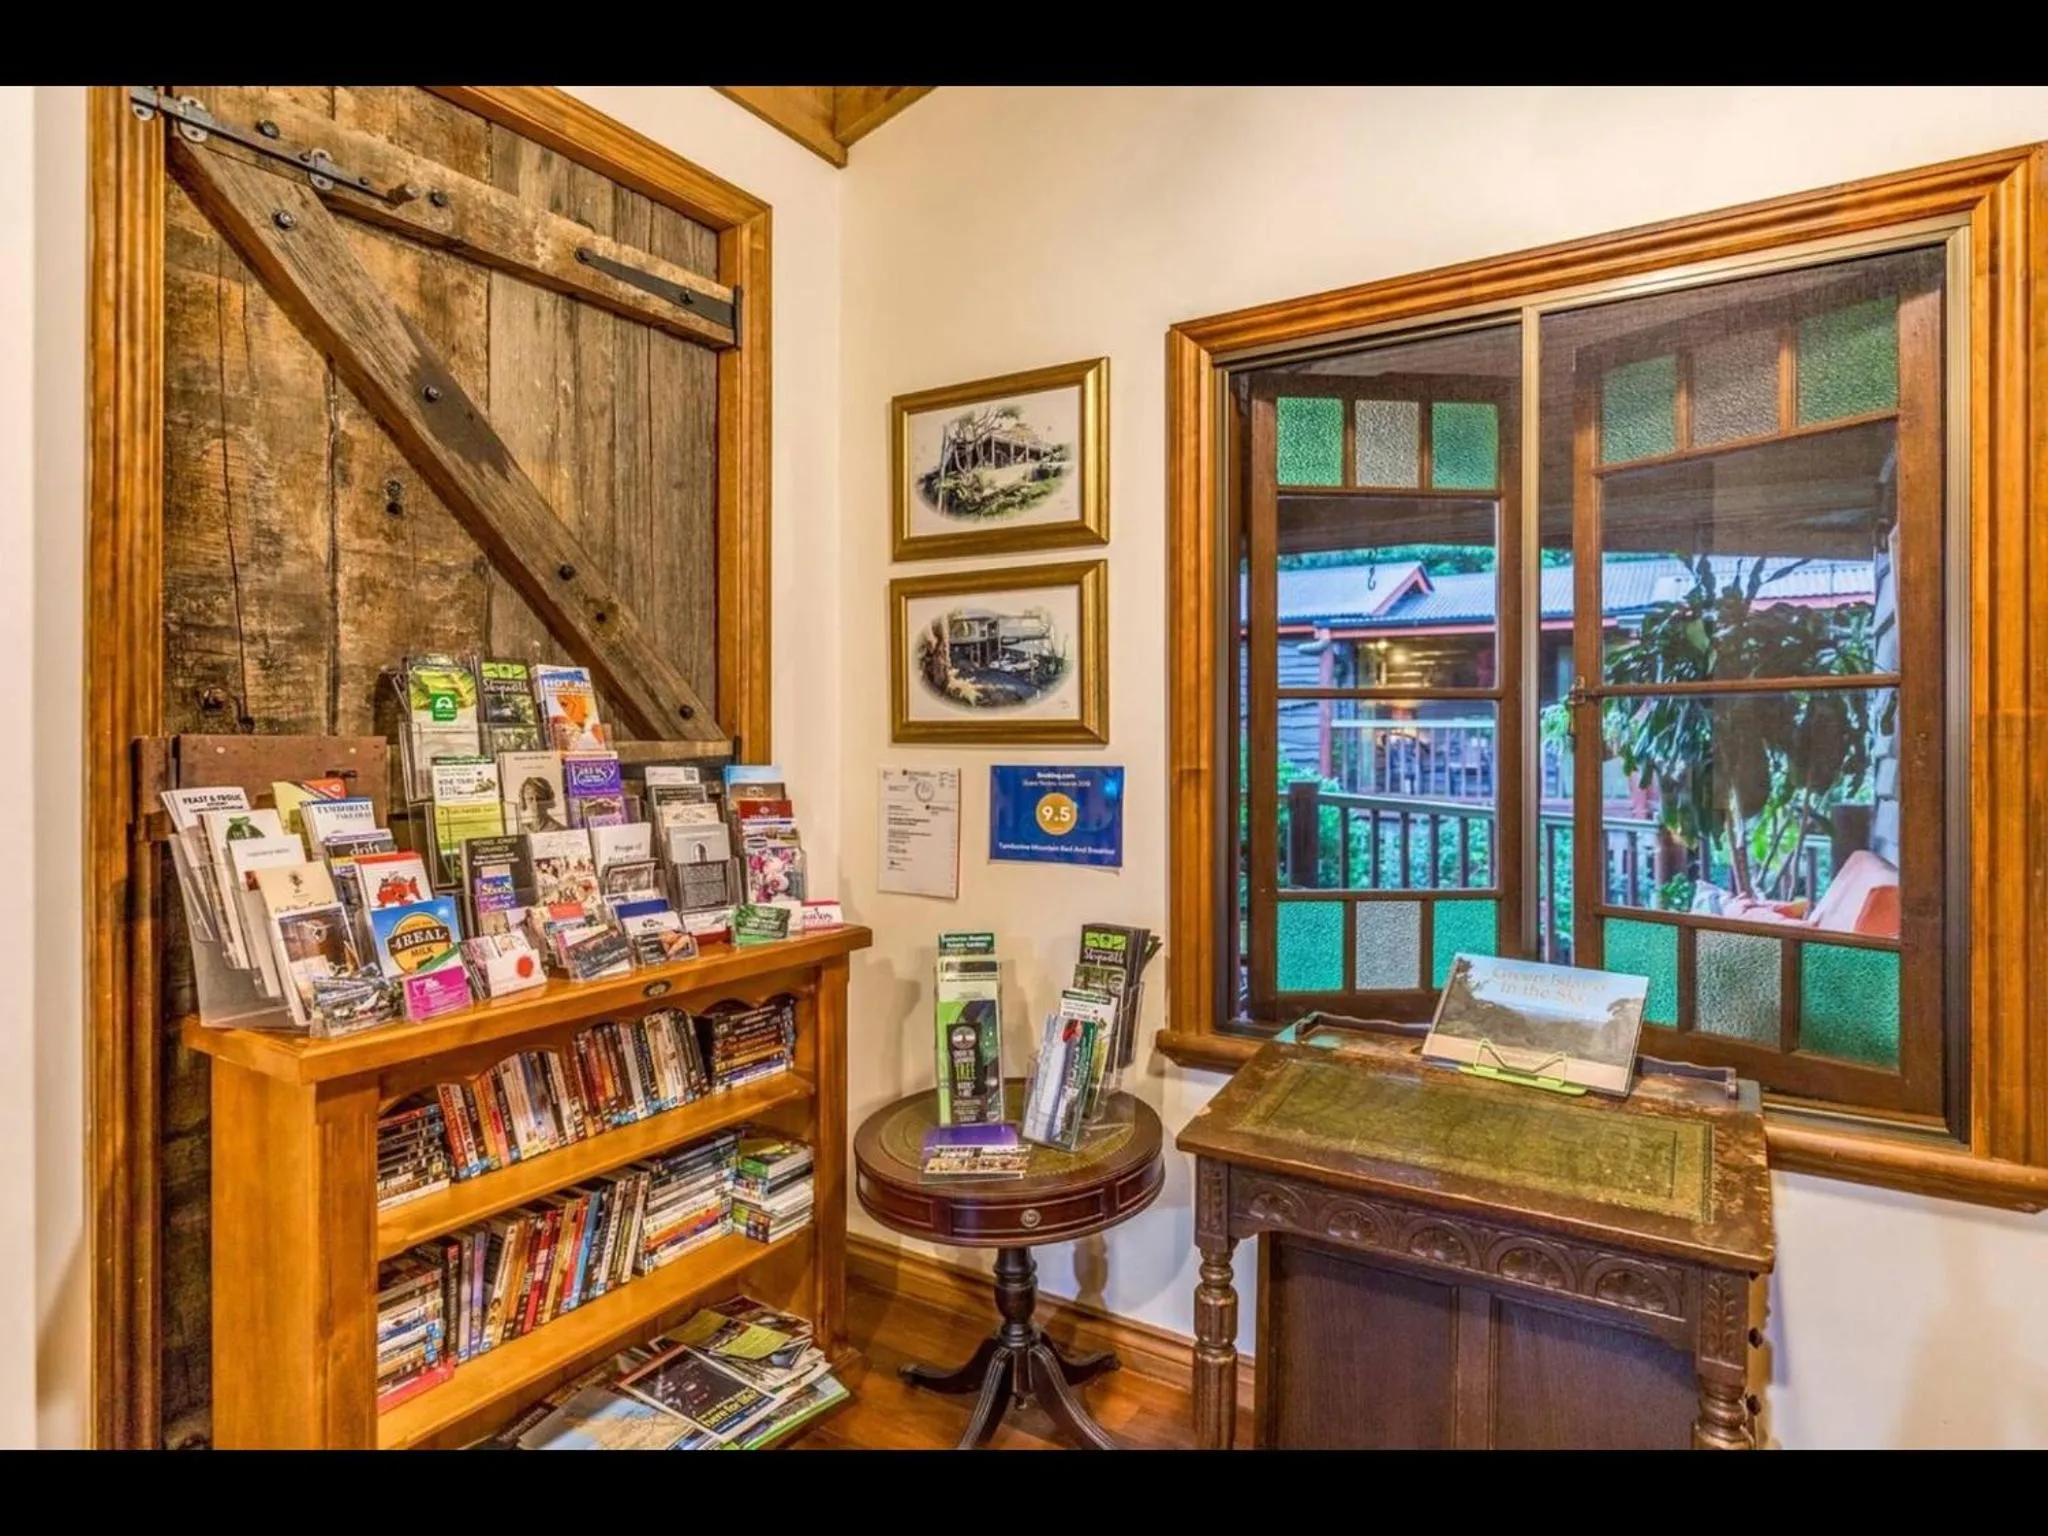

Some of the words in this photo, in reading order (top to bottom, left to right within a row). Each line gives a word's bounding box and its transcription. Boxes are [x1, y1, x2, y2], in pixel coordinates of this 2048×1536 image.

[1036, 772, 1076, 780] Booking.com
[182, 795, 207, 804] FEAST
[1041, 805, 1071, 822] 9.5
[998, 841, 1030, 851] Tamborine
[1031, 843, 1060, 852] Mountain
[1060, 844, 1073, 852] Bed
[411, 946, 433, 957] MILK
